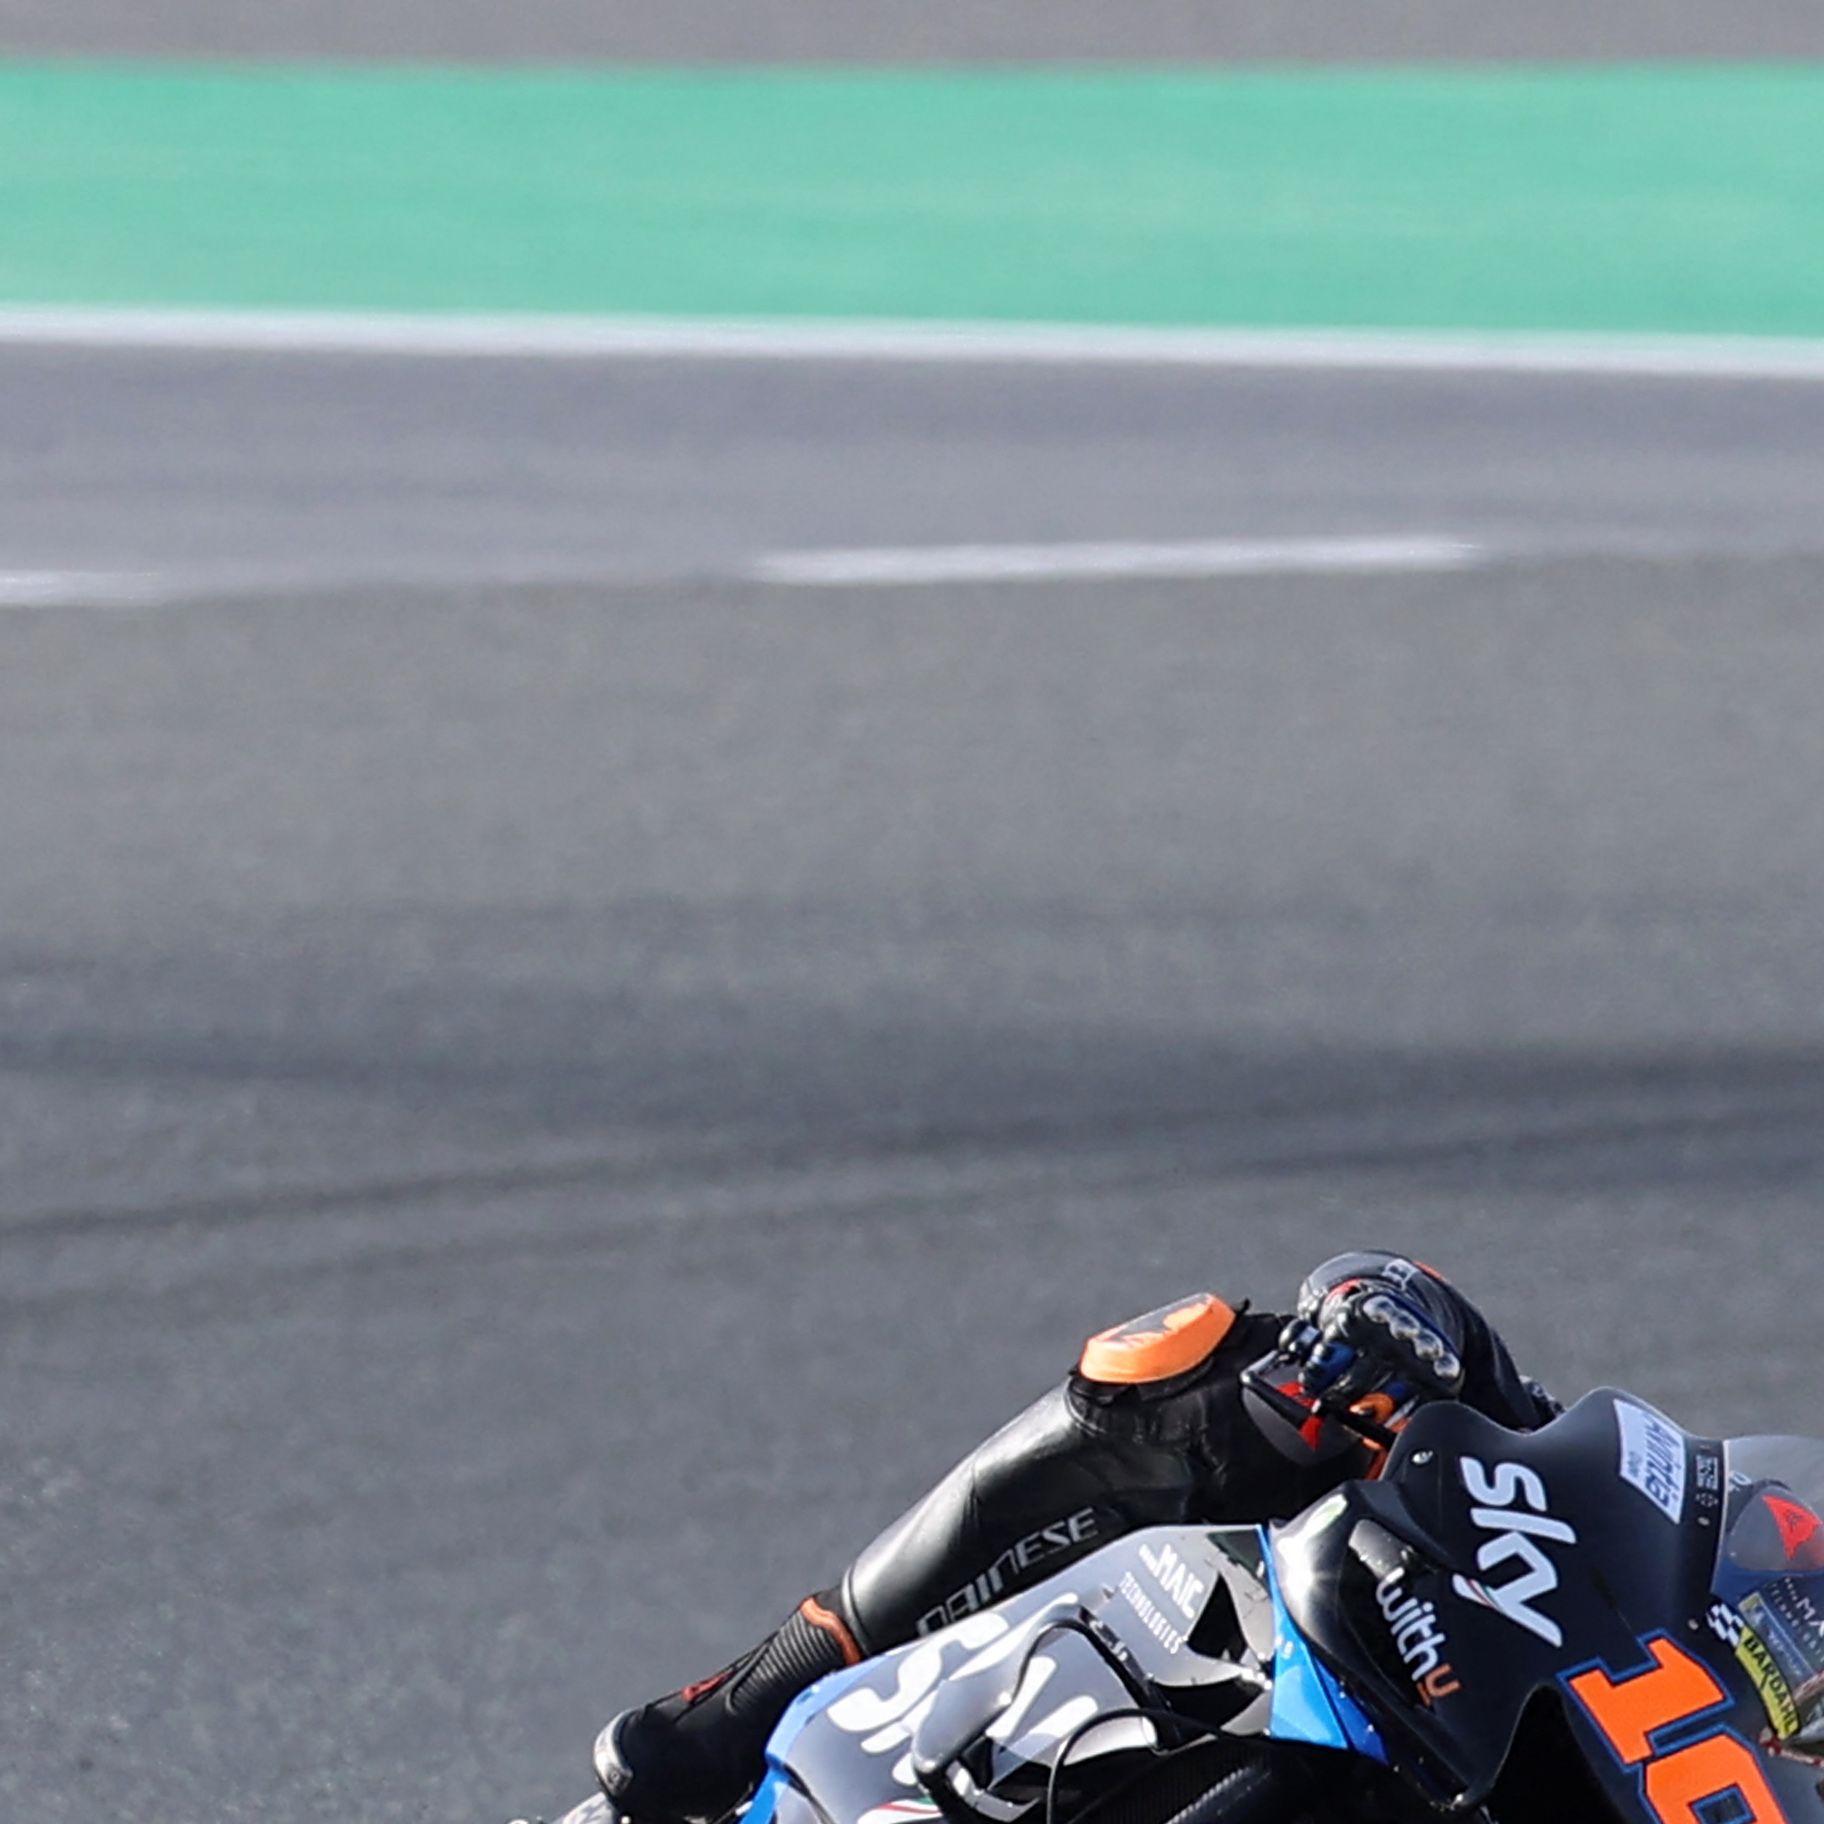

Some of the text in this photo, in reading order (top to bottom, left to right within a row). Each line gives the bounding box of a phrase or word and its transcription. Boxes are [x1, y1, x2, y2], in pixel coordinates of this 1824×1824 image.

[917, 1507, 1100, 1636] DAINESE
[1452, 1456, 1577, 1648] sky
[1744, 1632, 1801, 1734] BARDAHL
